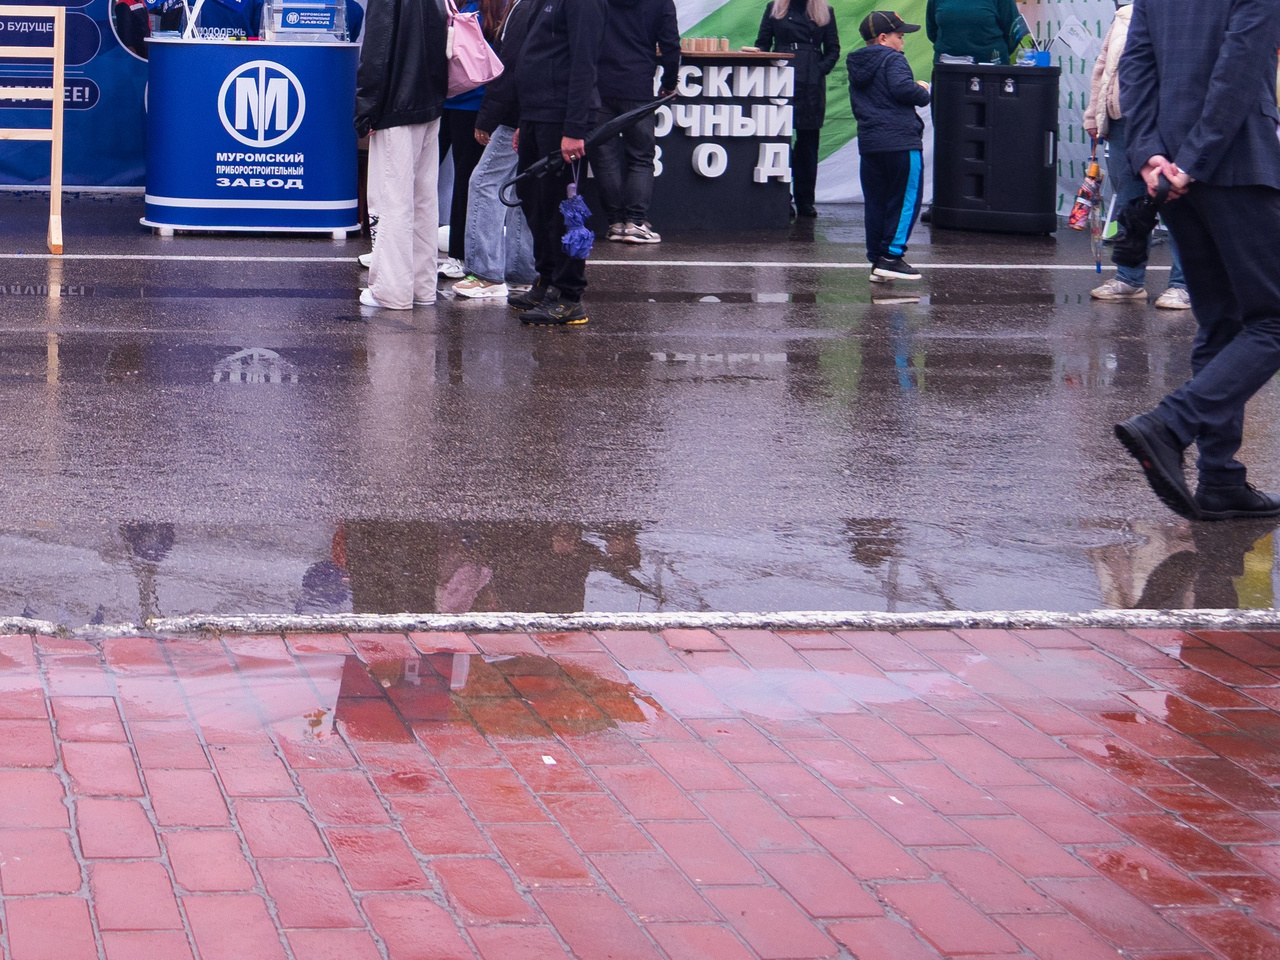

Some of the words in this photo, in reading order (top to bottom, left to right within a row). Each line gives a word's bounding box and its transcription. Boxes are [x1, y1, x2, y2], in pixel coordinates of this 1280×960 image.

[7, 22, 55, 33] БУДУЩЕ
[216, 152, 304, 163] МУРОМСКИЙ
[216, 164, 304, 175] ПРИБОРОСТРОИТЕЛЬНЫЙ
[216, 177, 304, 189] ЗАВОД
